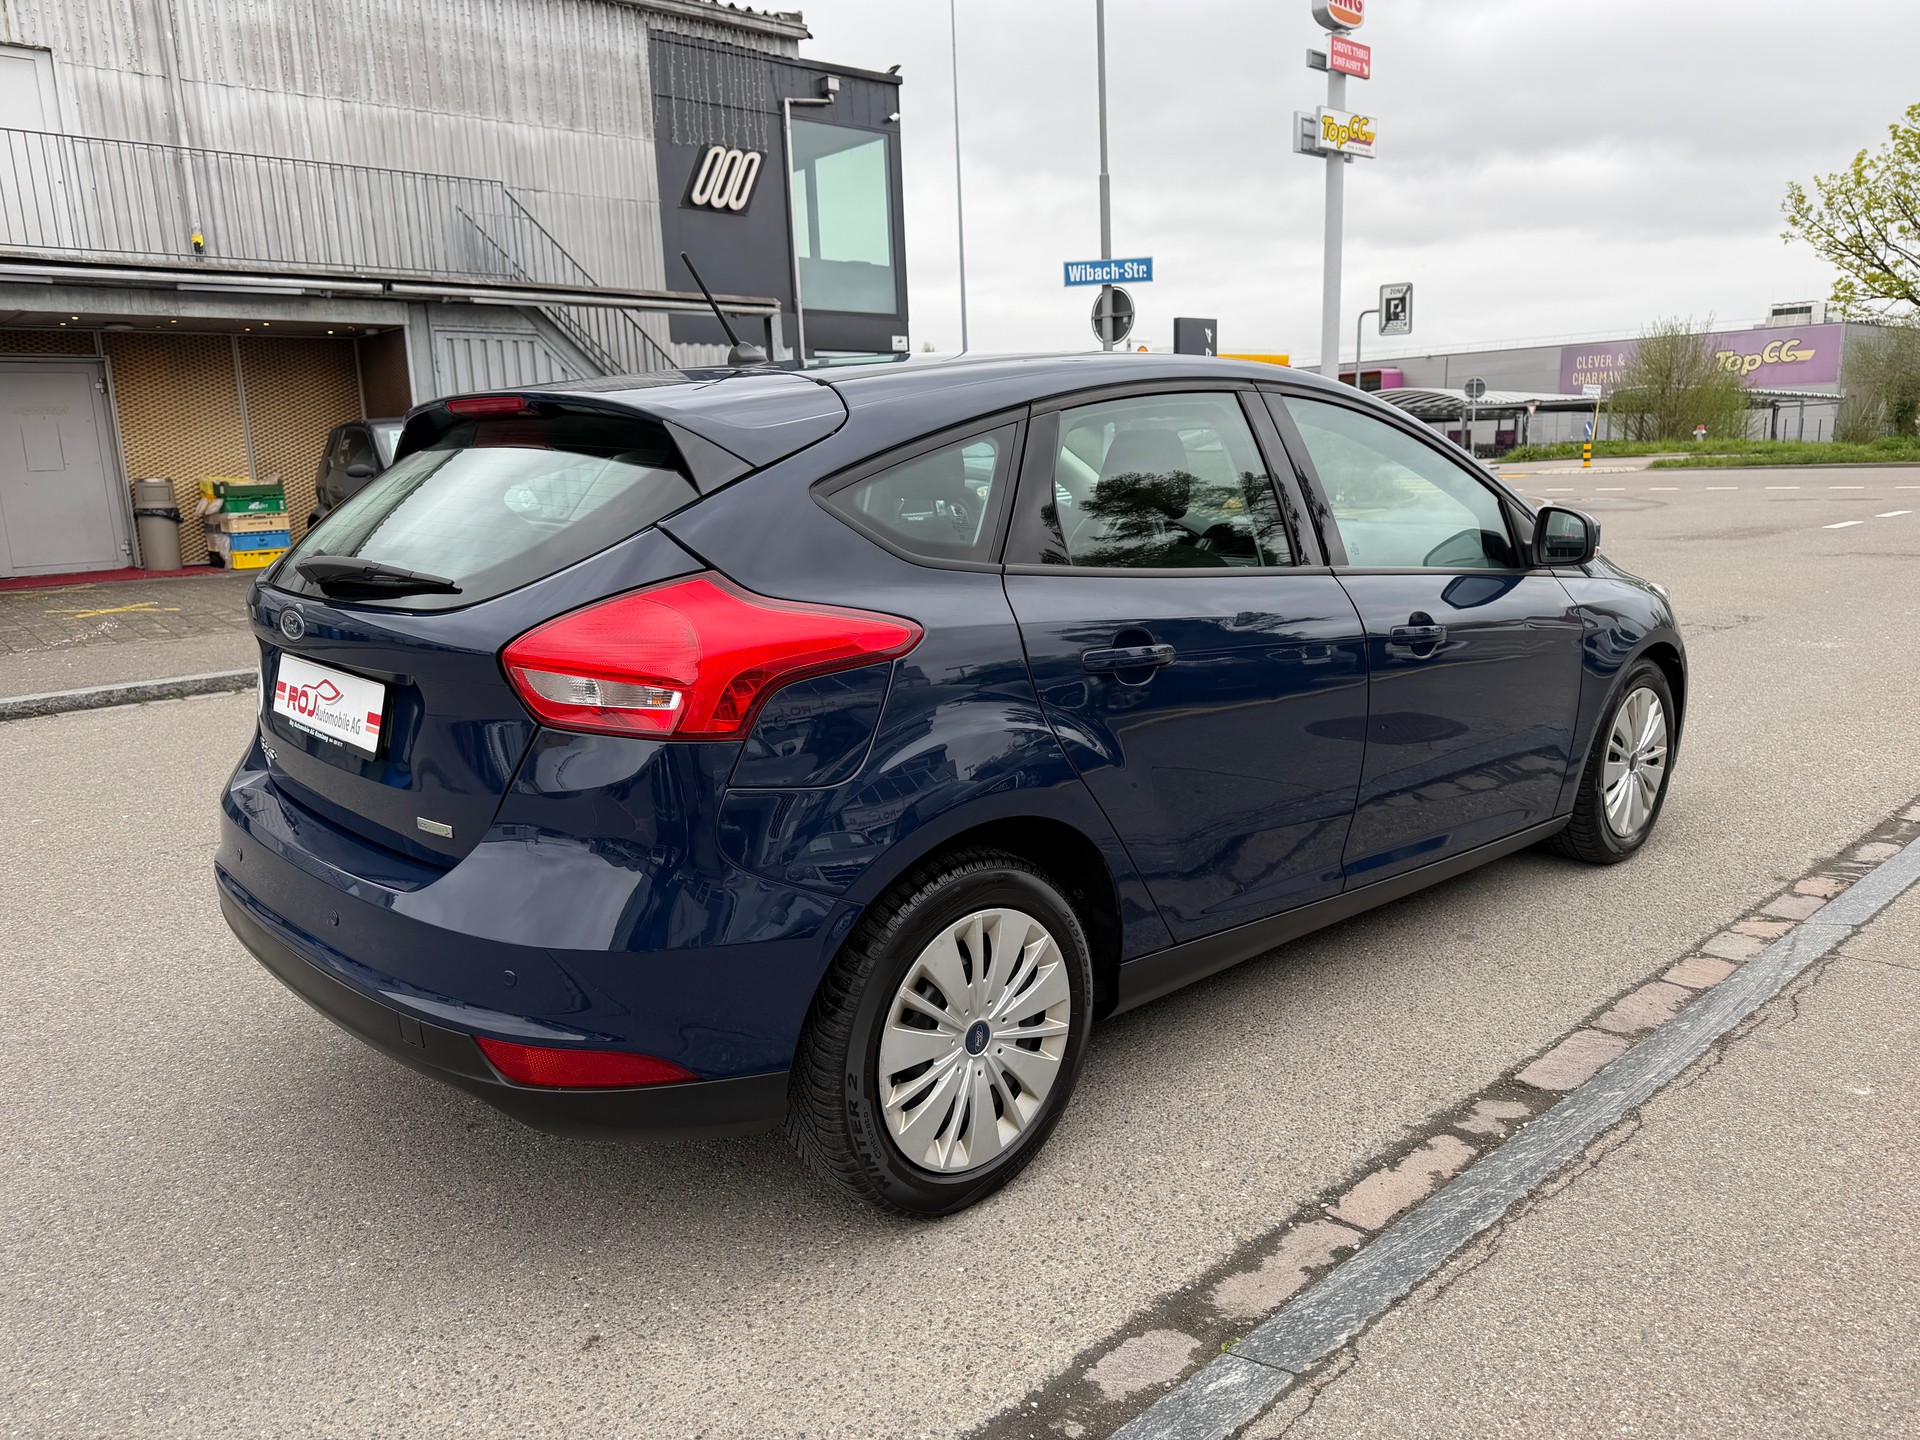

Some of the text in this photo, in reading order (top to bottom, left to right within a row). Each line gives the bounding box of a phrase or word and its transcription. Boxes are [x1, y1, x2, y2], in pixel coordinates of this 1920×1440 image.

[1333, 40, 1368, 60] DRIVE THRU
[1333, 55, 1361, 71] EINFAHRT
[1068, 262, 1147, 282] Wibach-Str.
[1576, 353, 1626, 369] CLEVER &
[1715, 339, 1802, 376] TopCC
[1572, 370, 1629, 386] CHARMAN
[287, 684, 318, 718] ROJ
[315, 705, 361, 735] Automobile AG
[1062, 911, 1088, 967] 205/55
[848, 1072, 891, 1191] WINTER 2
